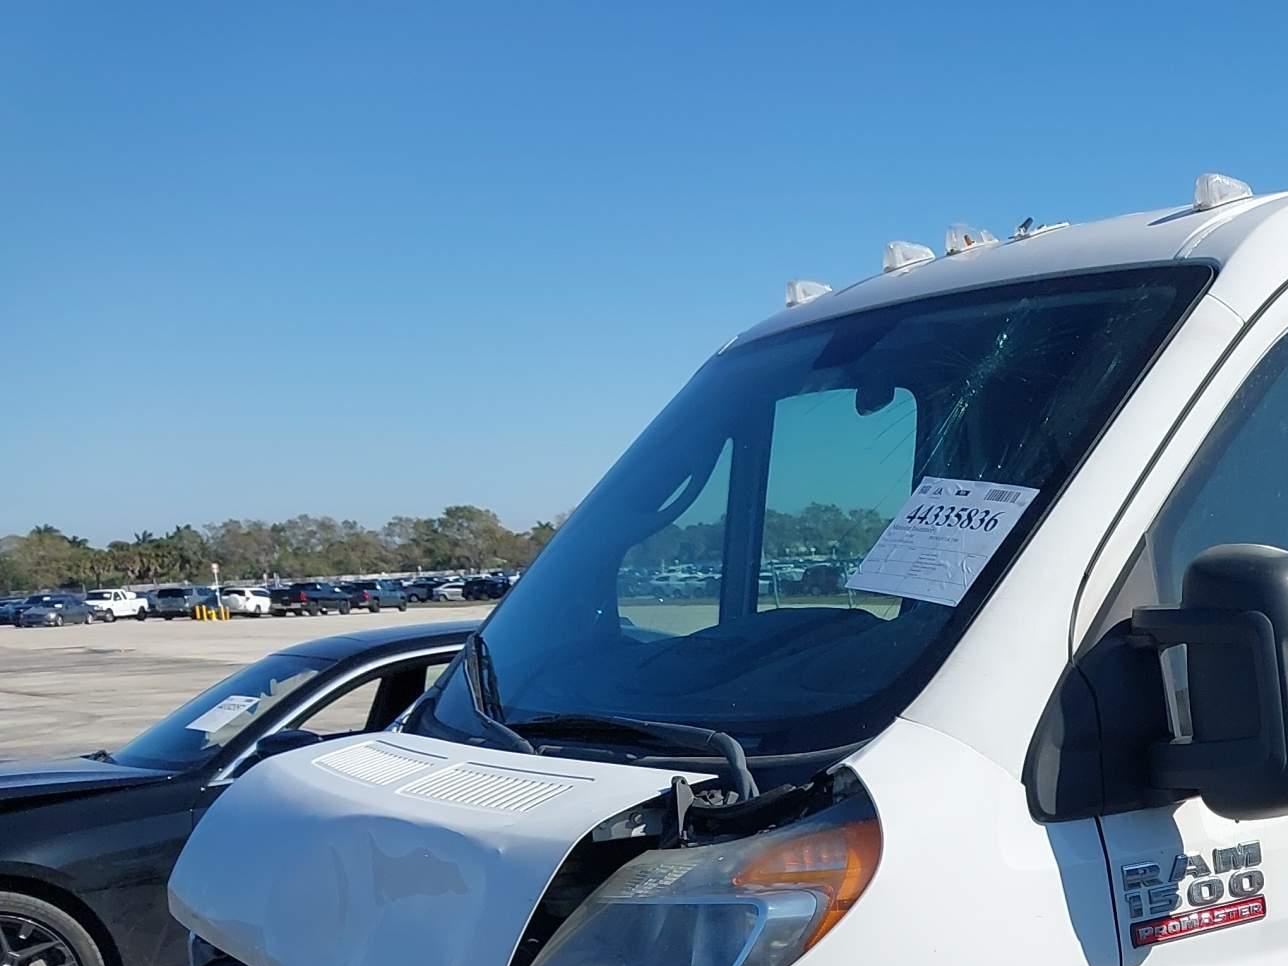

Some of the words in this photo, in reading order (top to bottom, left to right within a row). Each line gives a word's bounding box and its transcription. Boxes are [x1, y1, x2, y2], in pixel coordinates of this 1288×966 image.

[906, 502, 1005, 533] 44335836
[1121, 840, 1263, 892] RAM
[1124, 870, 1266, 919] 1500
[1137, 902, 1264, 942] PROMASTER
